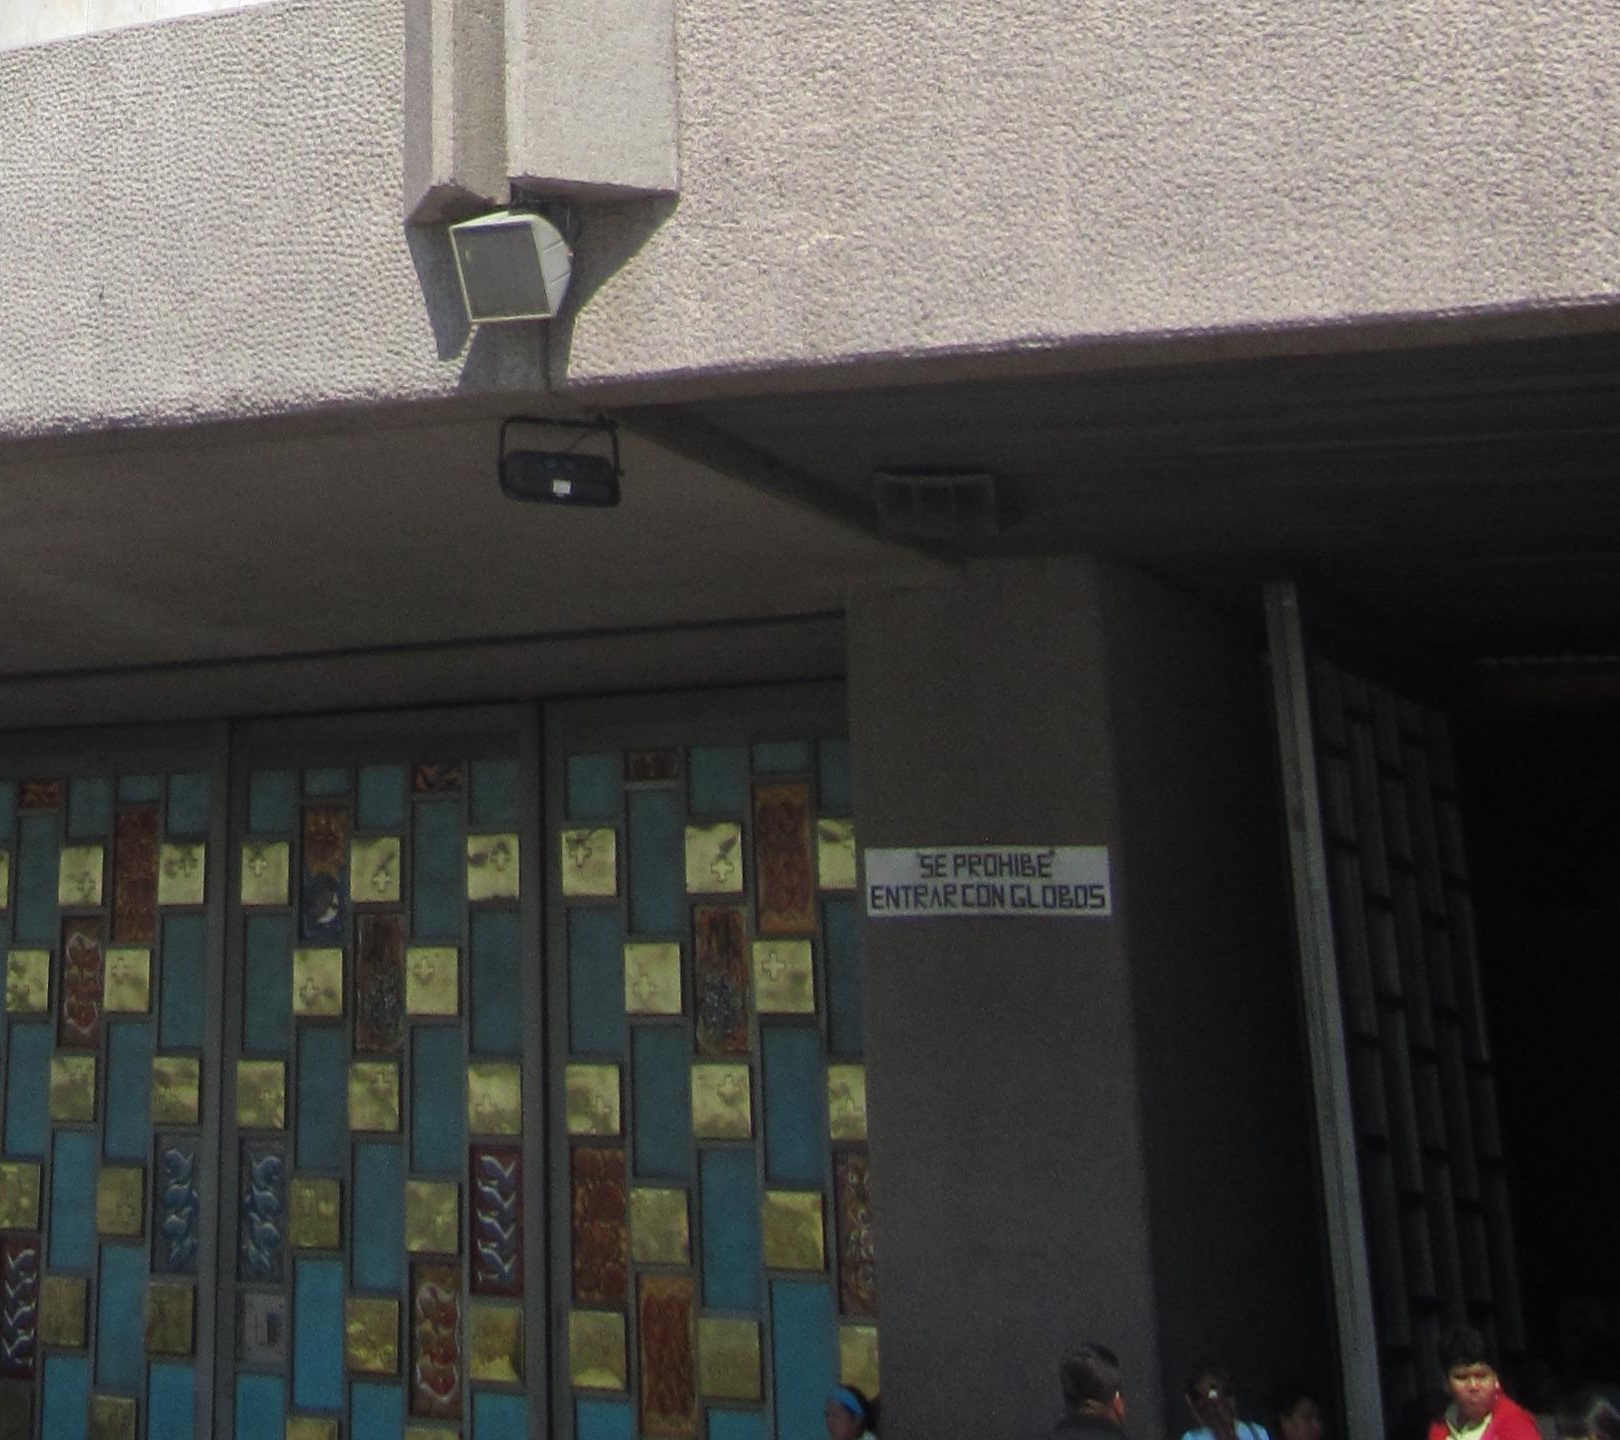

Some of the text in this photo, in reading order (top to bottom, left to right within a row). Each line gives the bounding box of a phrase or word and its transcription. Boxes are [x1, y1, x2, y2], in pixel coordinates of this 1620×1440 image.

[870, 883, 1106, 910] ENTRAR CON GLOBOS
